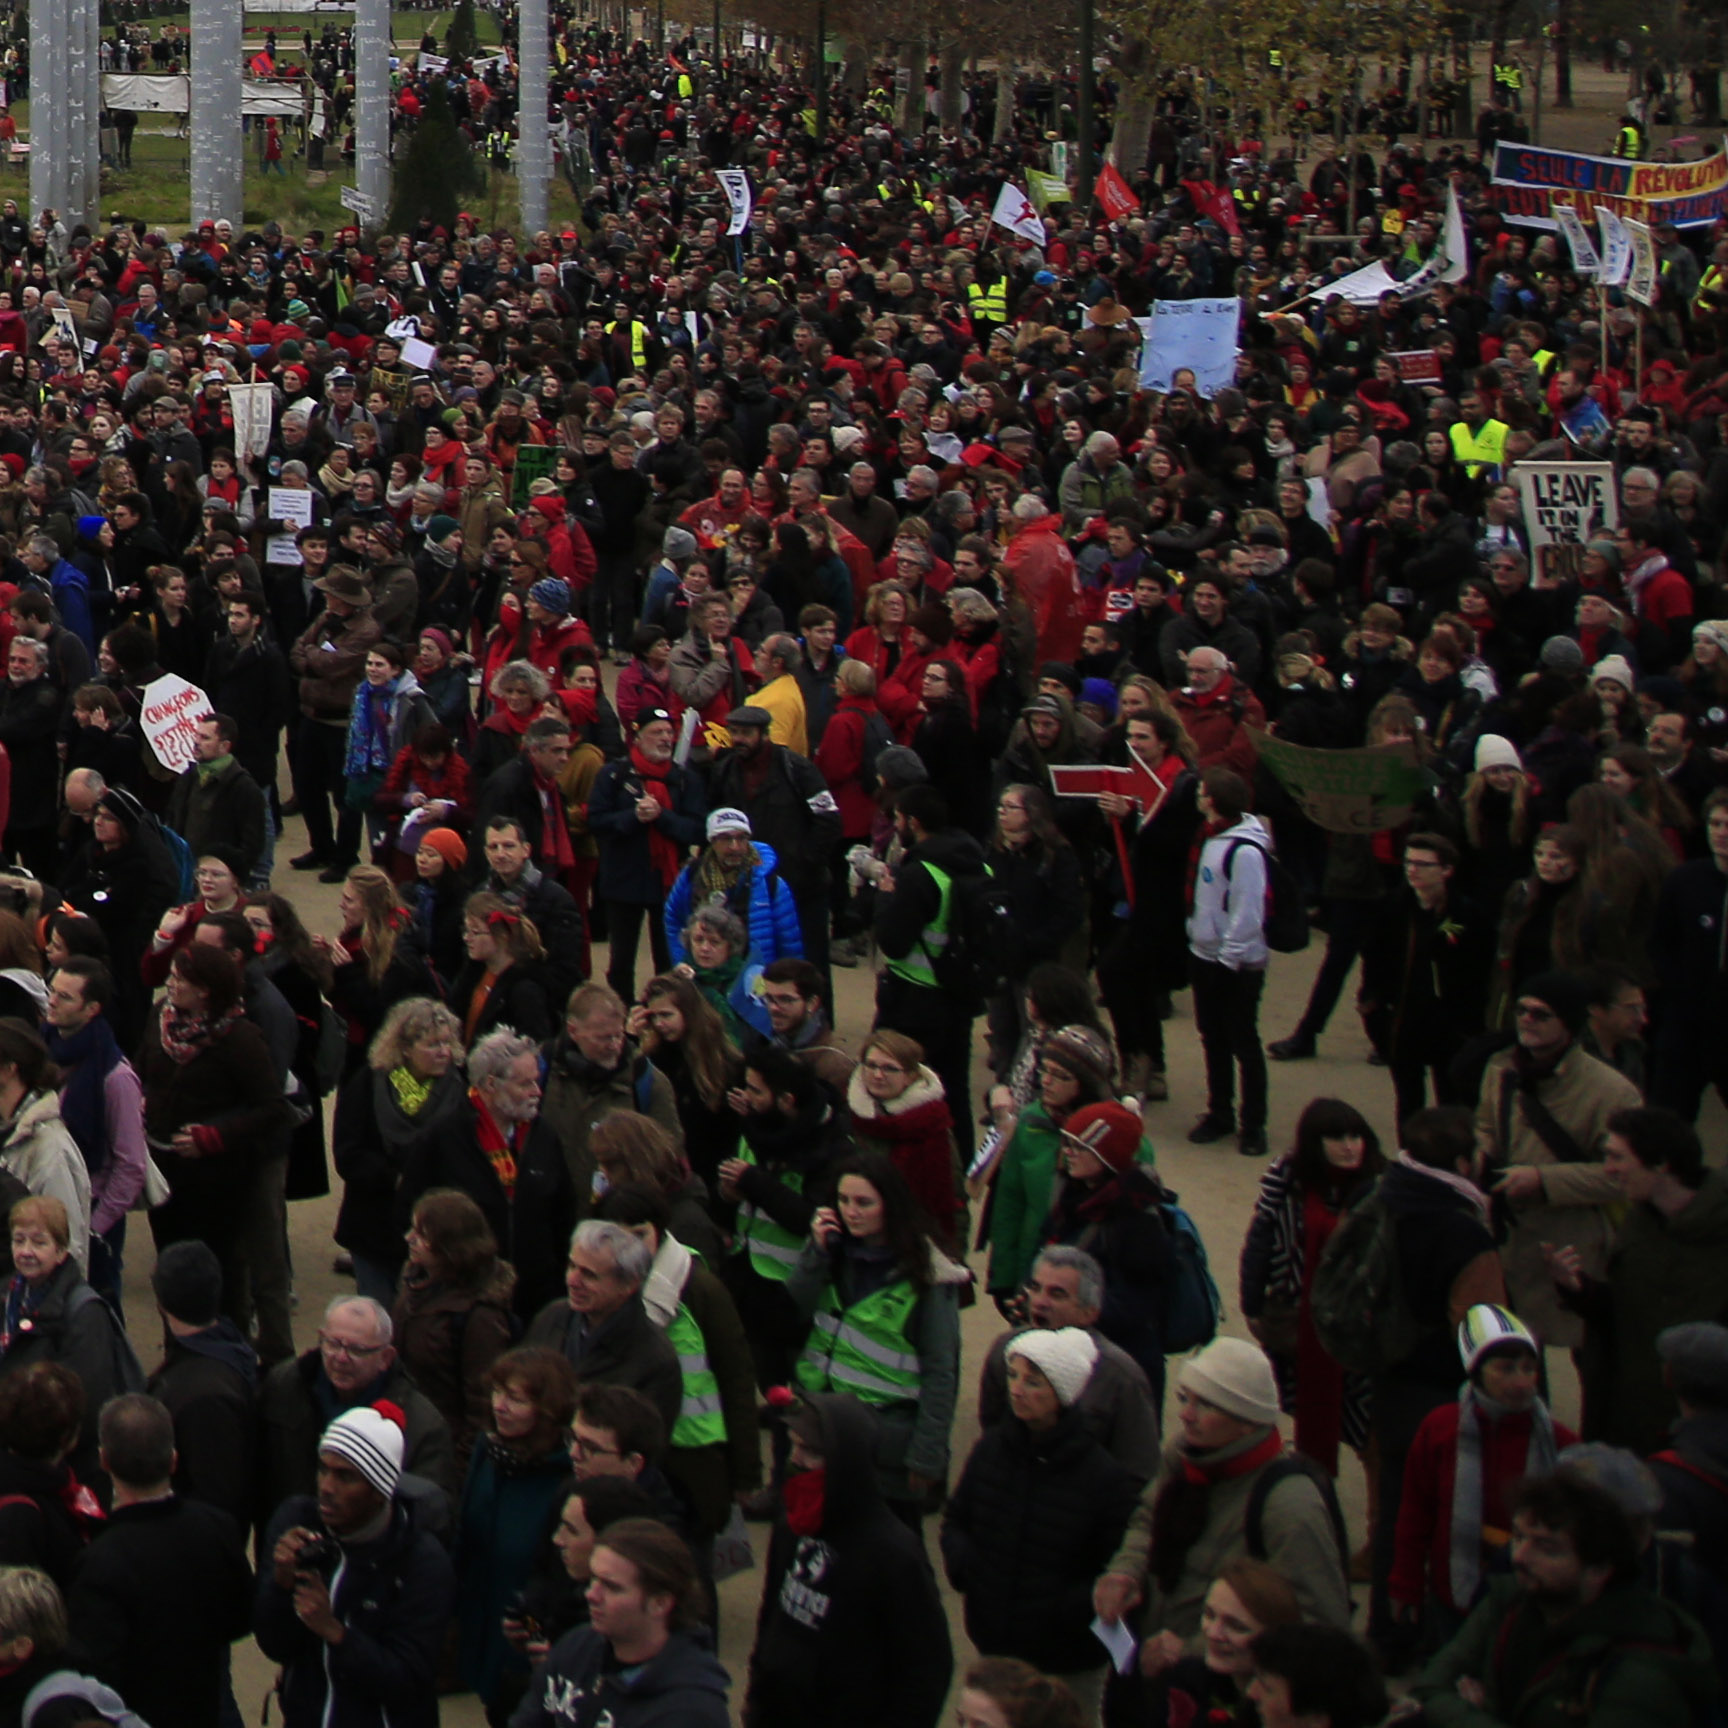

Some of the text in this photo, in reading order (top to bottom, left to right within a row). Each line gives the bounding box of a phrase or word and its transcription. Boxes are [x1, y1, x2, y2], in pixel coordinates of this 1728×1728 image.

[1519, 153, 1587, 186] SEULE
[1532, 473, 1604, 508] LEAVE
[1536, 509, 1579, 526] IT IN
[1545, 526, 1580, 544] THE
[144, 685, 201, 725] CHANGEONS
